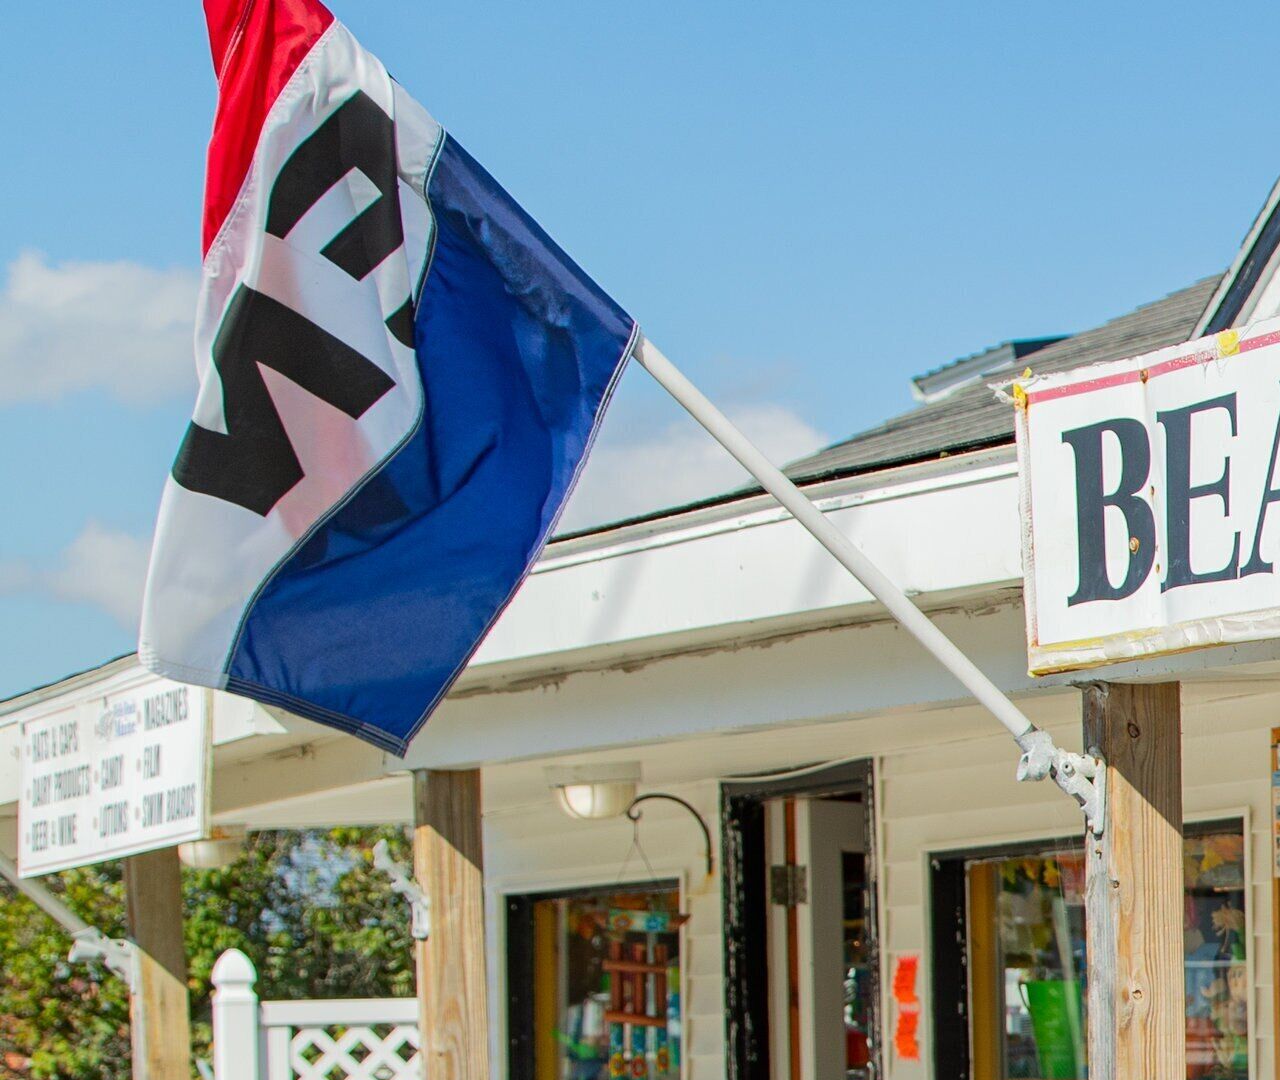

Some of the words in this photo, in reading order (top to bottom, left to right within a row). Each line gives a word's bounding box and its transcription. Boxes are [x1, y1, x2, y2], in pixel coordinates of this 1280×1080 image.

[144, 686, 188, 731] MAGAZINES
[32, 731, 49, 763] HATS
[52, 726, 57, 758] &
[59, 720, 78, 756] CAPS
[101, 754, 124, 791] CANDY
[143, 744, 160, 779] FILM
[32, 774, 52, 807] DAIRY
[53, 763, 90, 802] PRODUCTS
[32, 820, 49, 852] BEER
[58, 813, 77, 846] WINE
[100, 800, 128, 838] LOTIONS
